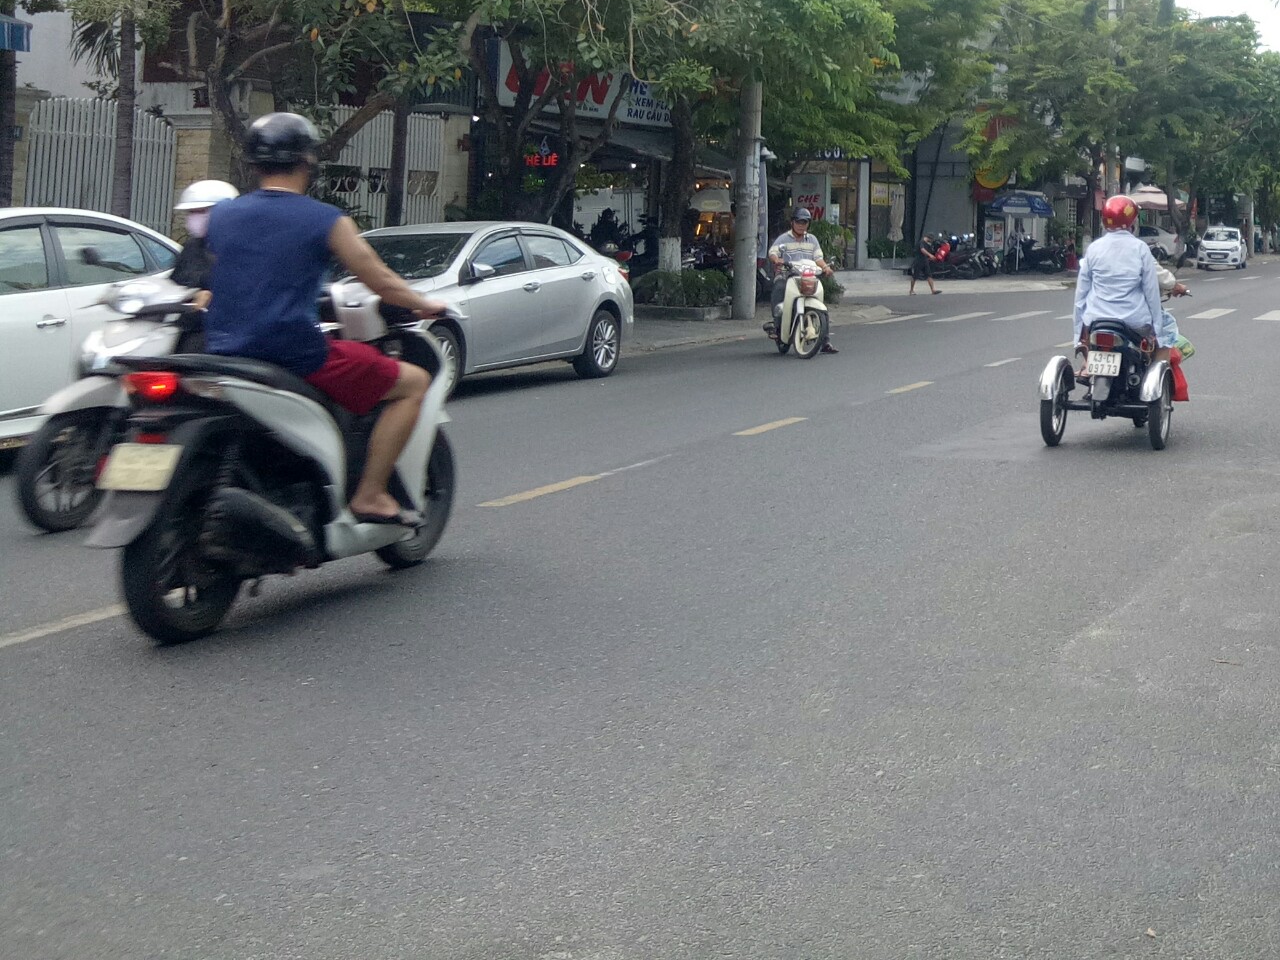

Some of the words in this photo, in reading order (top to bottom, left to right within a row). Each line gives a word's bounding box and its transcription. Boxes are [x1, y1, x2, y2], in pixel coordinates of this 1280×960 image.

[635, 97, 654, 108] KEM
[627, 108, 645, 120] RAU
[1093, 353, 1115, 364] 43-C1
